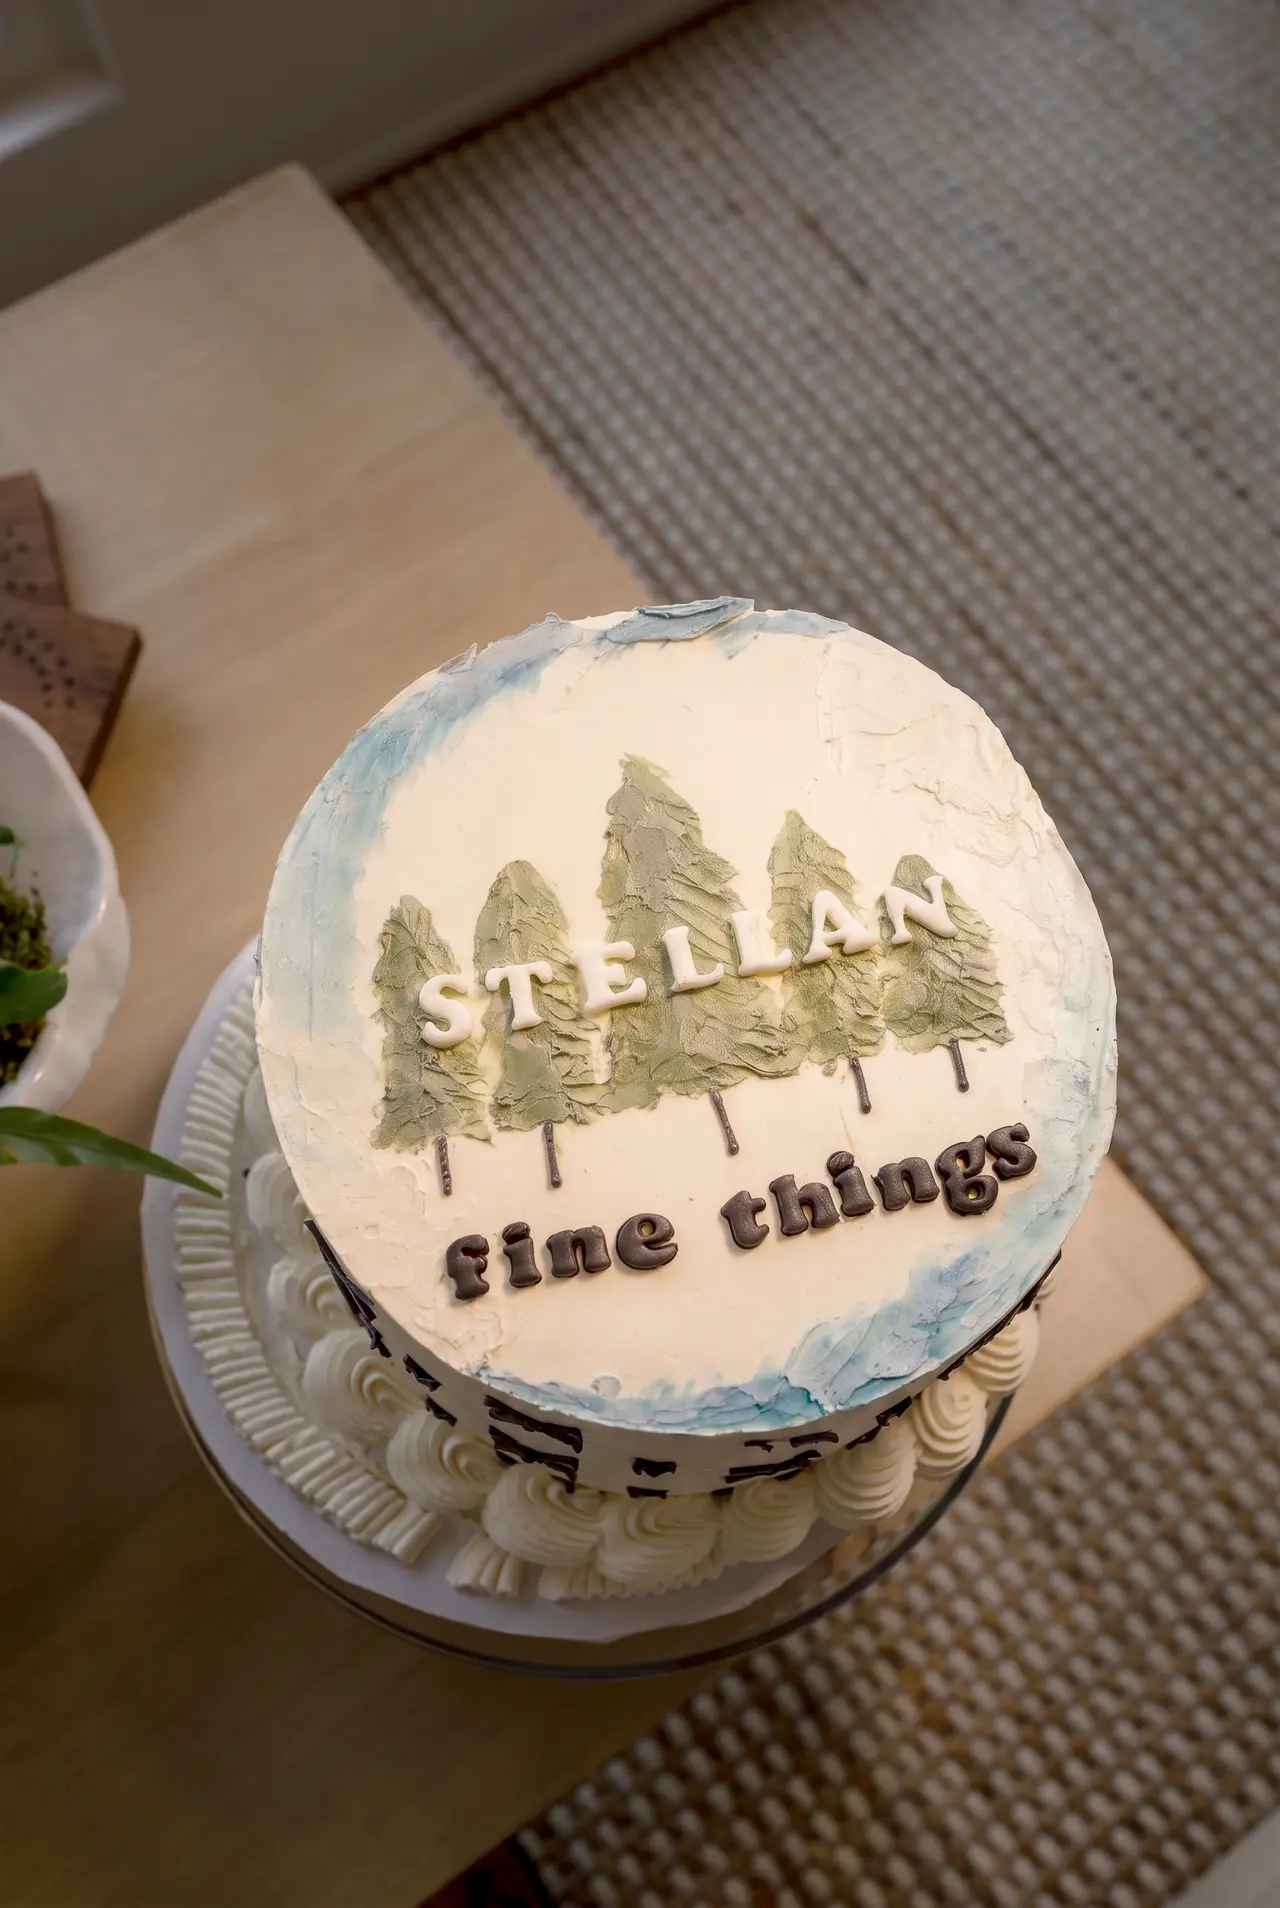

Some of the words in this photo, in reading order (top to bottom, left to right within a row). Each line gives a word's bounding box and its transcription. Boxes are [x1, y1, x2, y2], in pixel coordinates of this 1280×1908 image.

[419, 875, 959, 1048] STELLAN
[446, 1213, 679, 1300] fine
[720, 1122, 1037, 1249] things
